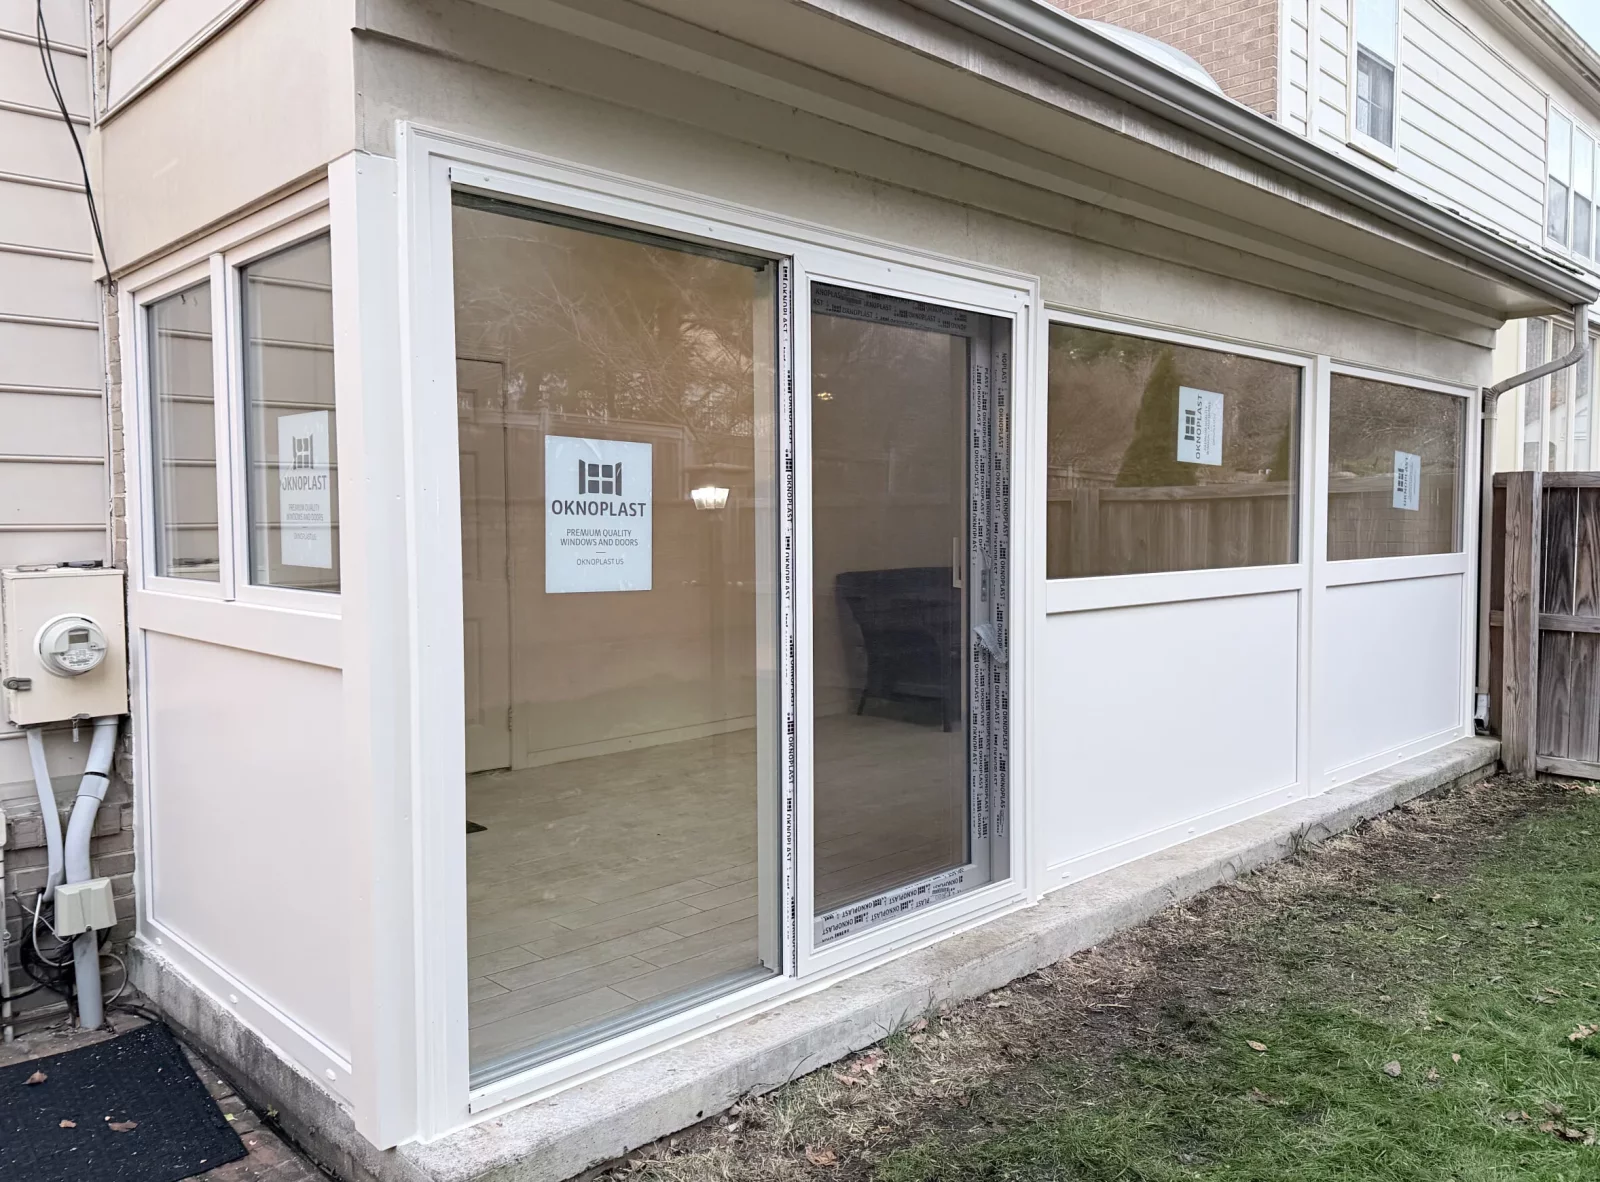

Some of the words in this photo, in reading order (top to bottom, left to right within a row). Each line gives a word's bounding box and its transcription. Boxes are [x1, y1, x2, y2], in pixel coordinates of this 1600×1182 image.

[552, 500, 646, 517] OKNOPLAST
[566, 529, 601, 537] PREMIUM
[889, 890, 917, 904] OKNOPLAST
[842, 902, 872, 918] OKNOPLAST
[871, 906, 900, 921] OKNOPLAST
[822, 919, 854, 935] OKNOPLAST
